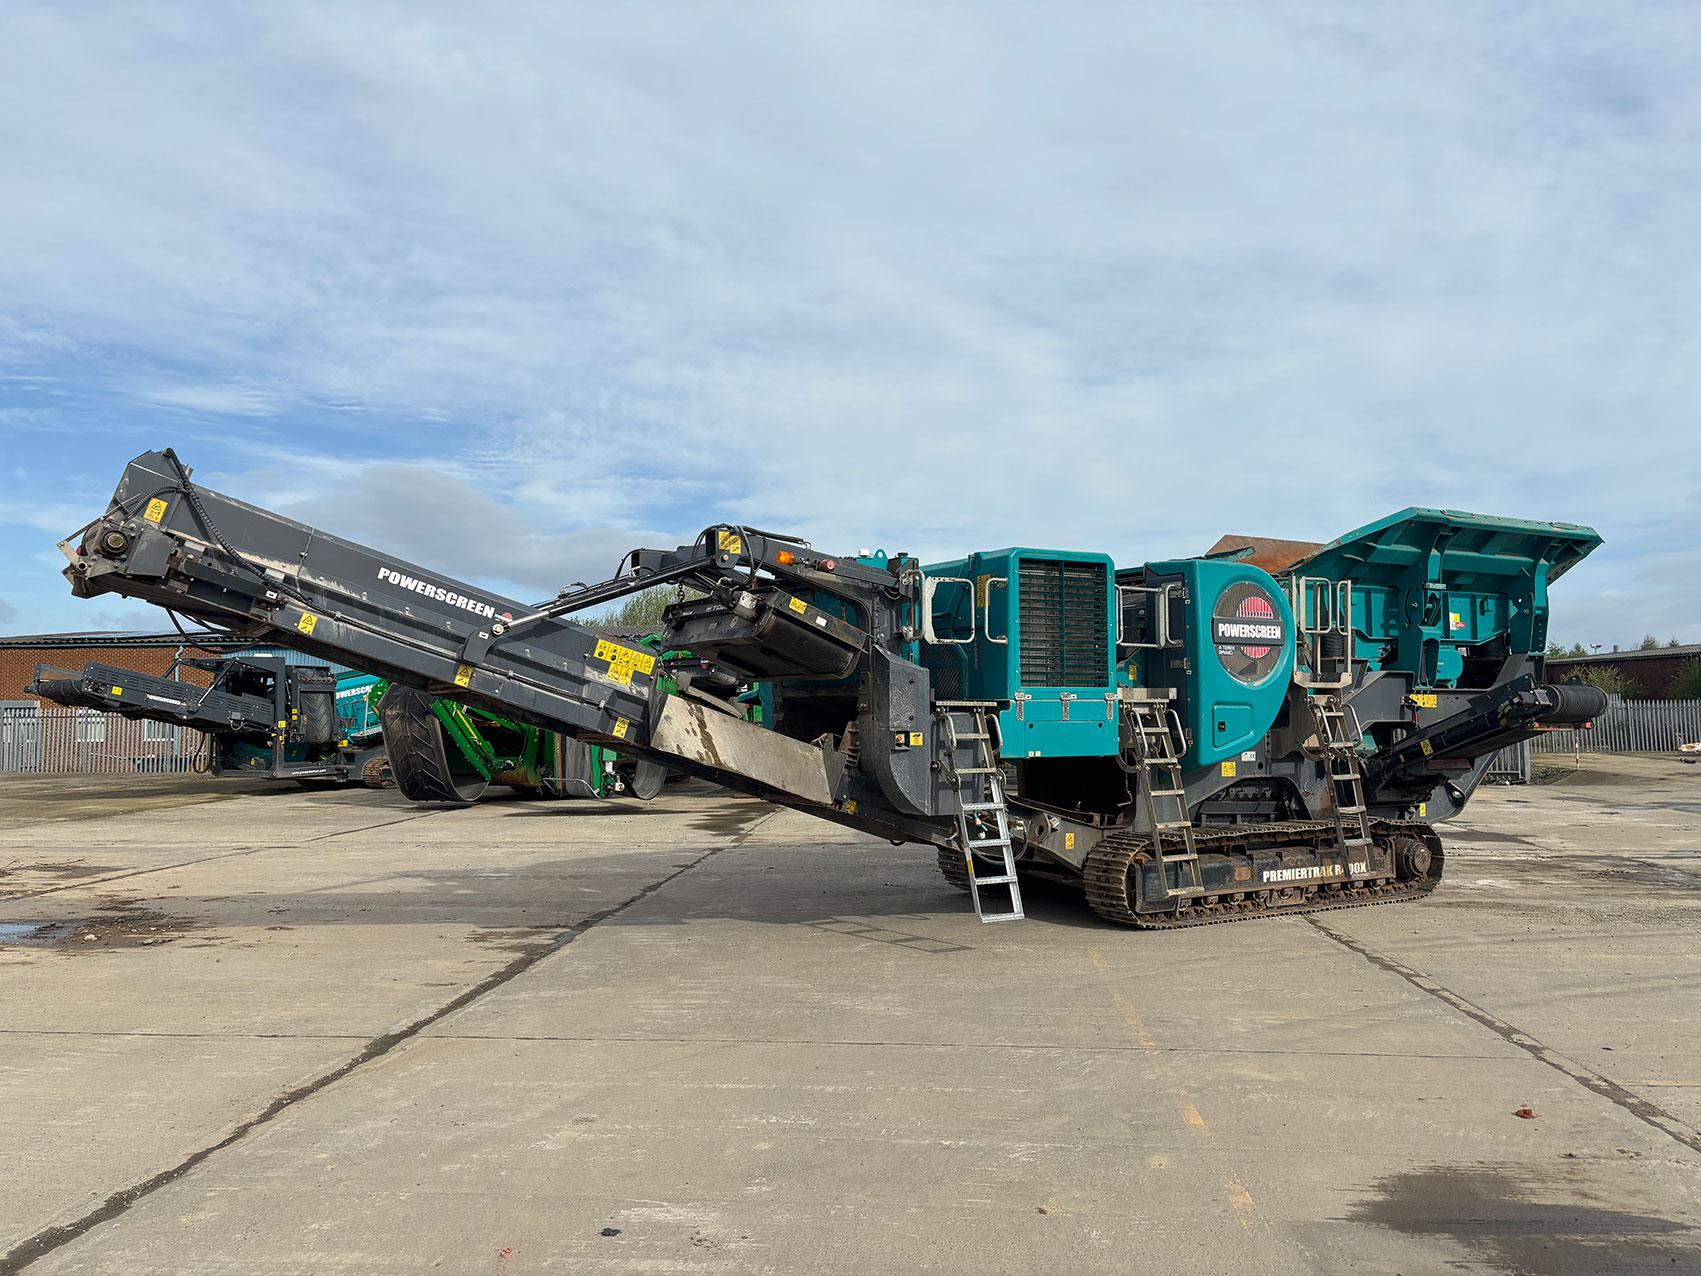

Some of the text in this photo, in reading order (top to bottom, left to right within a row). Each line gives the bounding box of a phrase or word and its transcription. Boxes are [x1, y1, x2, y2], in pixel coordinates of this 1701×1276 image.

[377, 567, 496, 619] POWERSCREEN
[1218, 623, 1281, 639] POWERSCREEN
[1263, 861, 1367, 882] PREMIERTRAK R00X
